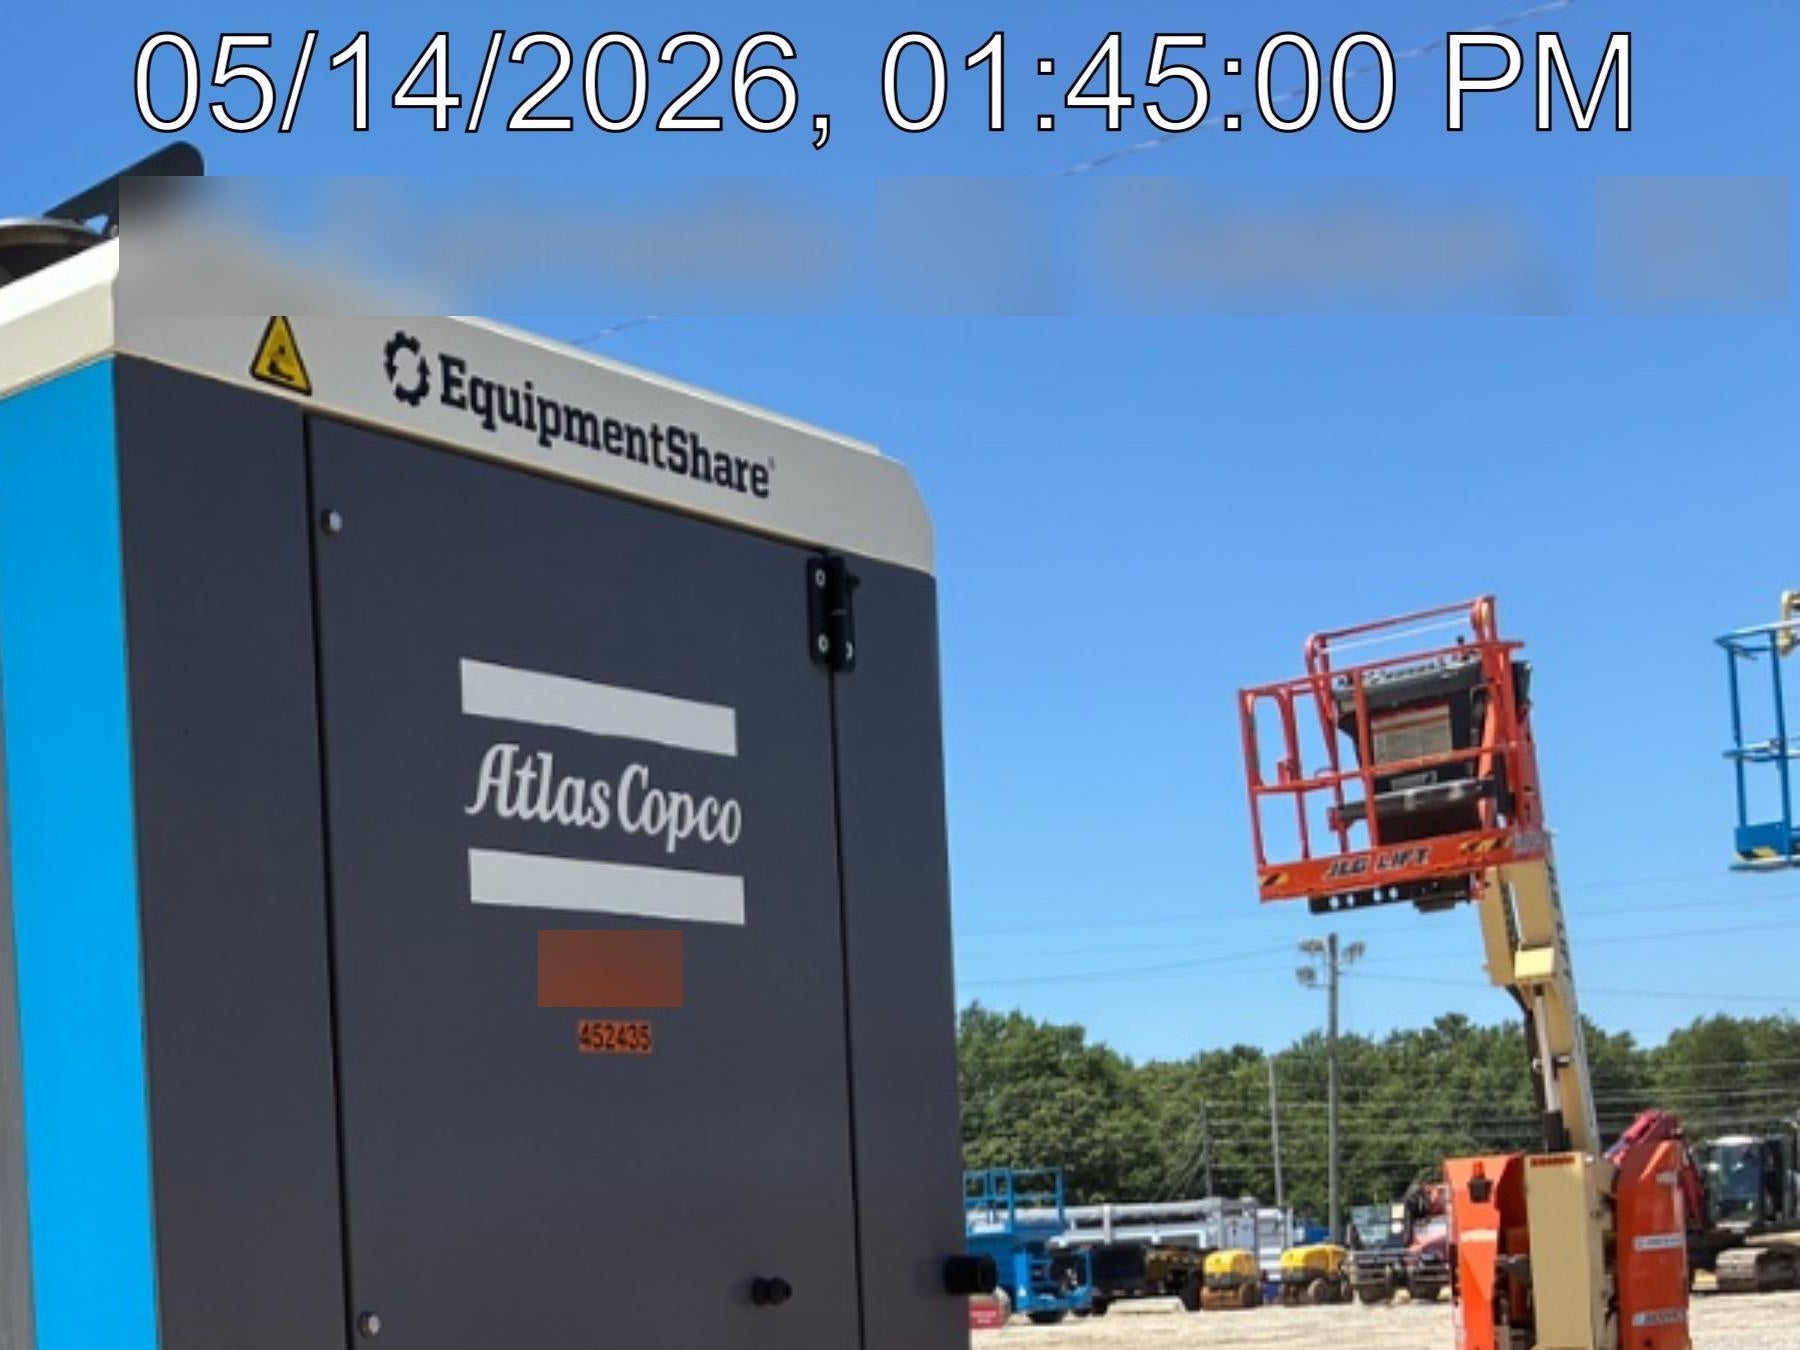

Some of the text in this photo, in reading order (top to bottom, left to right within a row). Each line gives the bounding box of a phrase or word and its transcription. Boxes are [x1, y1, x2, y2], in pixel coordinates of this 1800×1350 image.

[438, 353, 770, 498] EquipmentShare
[465, 743, 742, 853] Atlas Copco
[580, 1022, 650, 1050] 452435
